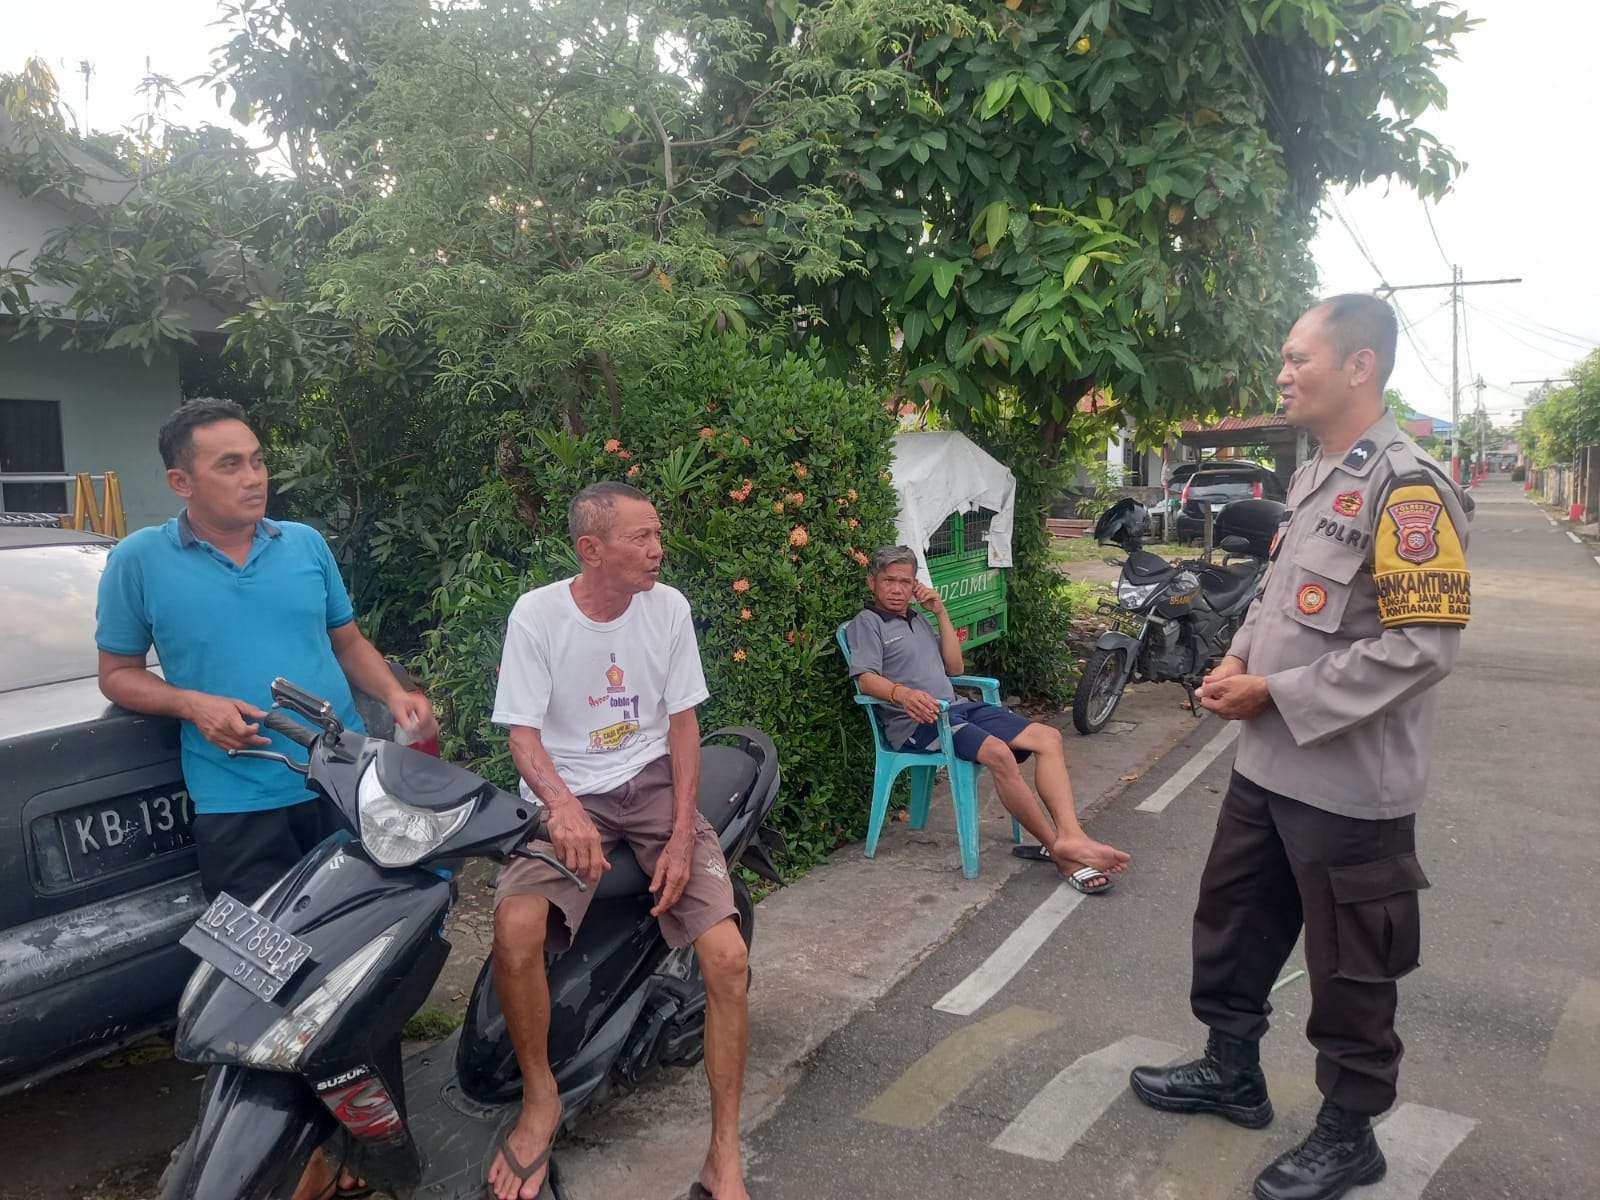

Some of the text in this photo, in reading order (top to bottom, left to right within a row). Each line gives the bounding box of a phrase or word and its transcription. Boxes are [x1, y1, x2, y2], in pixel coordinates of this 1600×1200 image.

[1315, 517, 1370, 550] POLRI
[934, 573, 987, 602] OZOMI
[1416, 592, 1442, 603] JAWI
[1385, 603, 1441, 616] PONTIANAK
[630, 695, 639, 718] 1
[75, 810, 124, 854] KB
